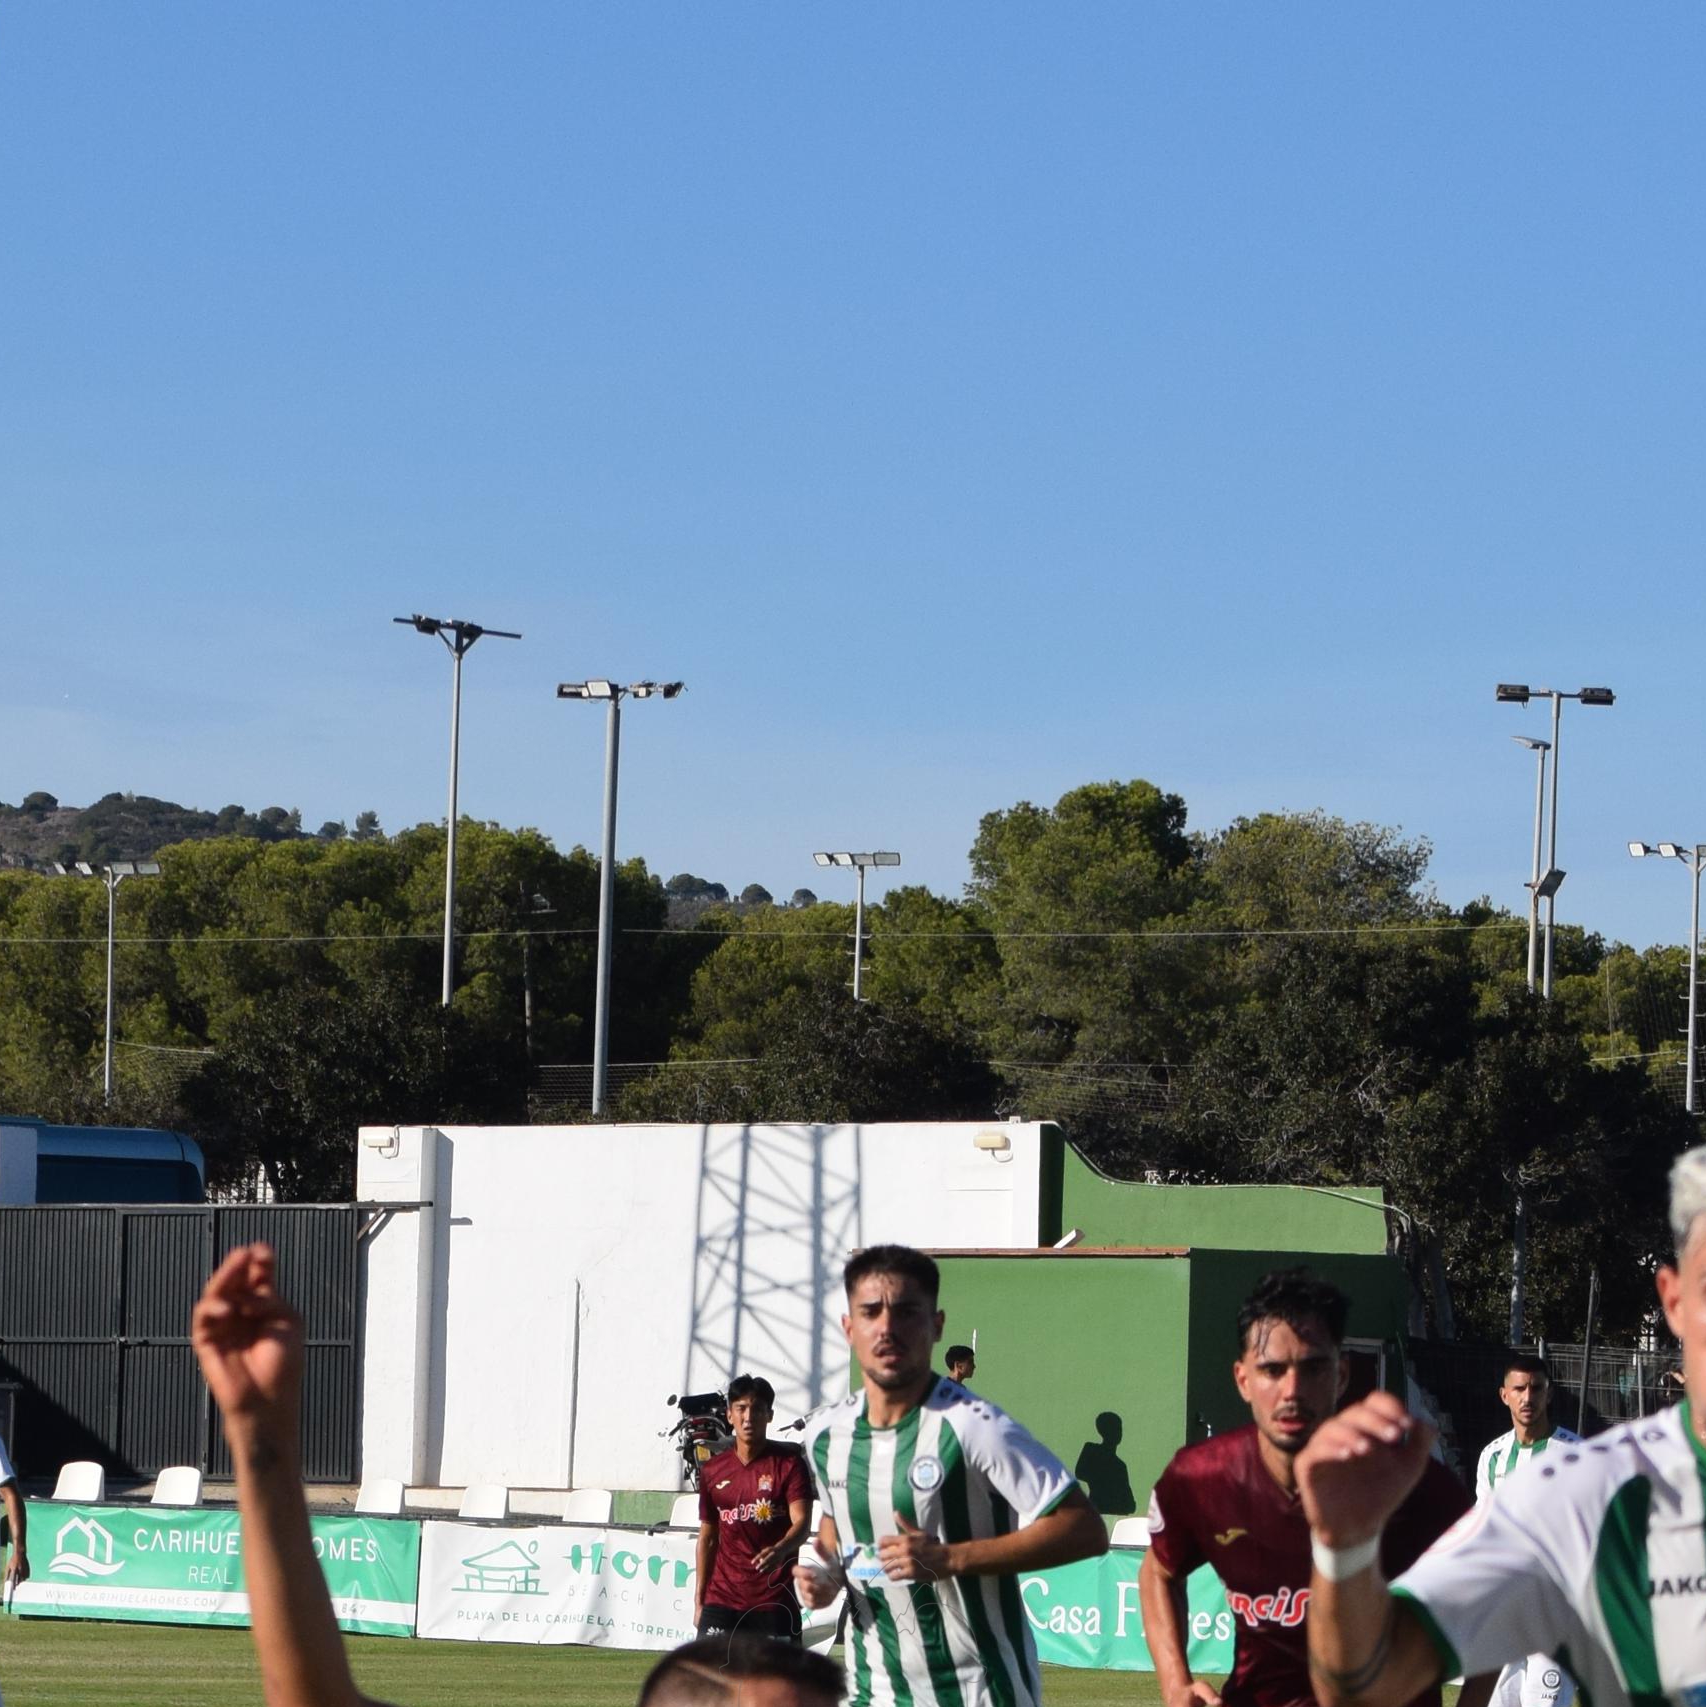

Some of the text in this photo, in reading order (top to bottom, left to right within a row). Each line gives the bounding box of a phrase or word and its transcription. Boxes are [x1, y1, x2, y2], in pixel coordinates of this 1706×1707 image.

[188, 1566, 234, 1585] REAL
[1019, 1577, 1102, 1635] Casa
[456, 1610, 495, 1621] PLAYA
[501, 1611, 520, 1622] DE
[525, 1613, 541, 1623] LA
[545, 1614, 616, 1629] CARIHUELA
